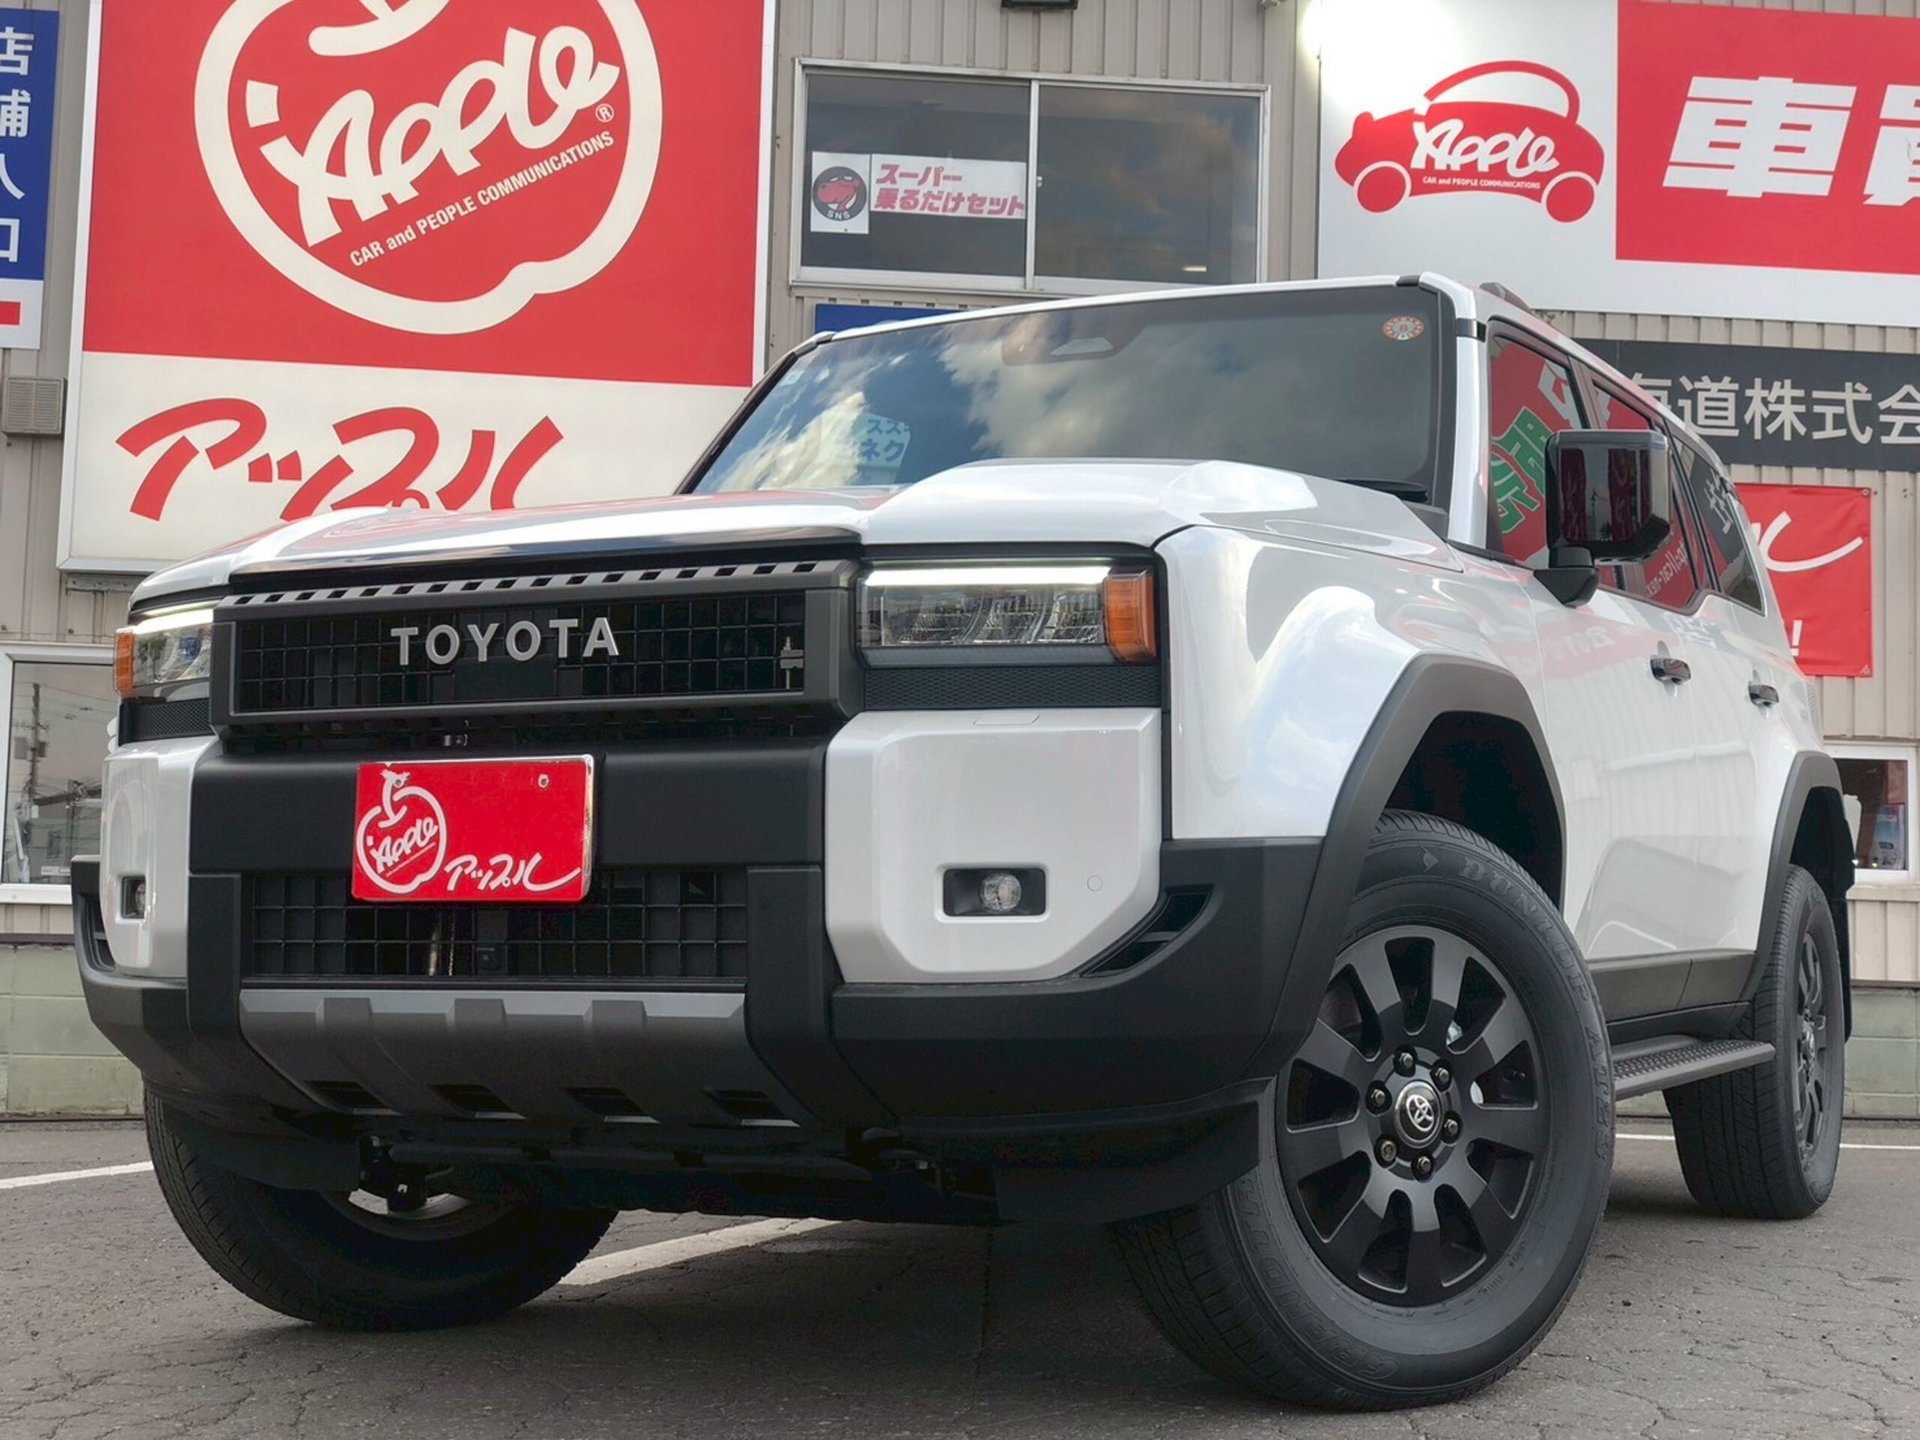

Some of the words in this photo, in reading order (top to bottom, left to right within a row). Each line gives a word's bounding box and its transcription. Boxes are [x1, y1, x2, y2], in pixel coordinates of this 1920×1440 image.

[260, 26, 620, 247] Apple
[1410, 118, 1560, 178] Apple
[350, 240, 385, 267] CAR
[386, 225, 417, 250] and
[416, 196, 477, 236] PEOPLE
[477, 131, 614, 206] COMMUNICATIONS
[874, 187, 1025, 216] 乗るだけセット
[876, 163, 962, 187] スーパー
[1422, 176, 1437, 184] CAR
[1438, 177, 1451, 185] and
[1452, 178, 1478, 187] PEOPLE
[1479, 179, 1541, 190] COMMUNICATIONS
[826, 209, 851, 220] SNS
[391, 617, 619, 666] TOYOTA
[369, 817, 439, 874] Apple
[444, 852, 582, 892] アップル
[1459, 857, 1592, 1003] DUNLOP
[1235, 1174, 1400, 1380] GRANDTR
